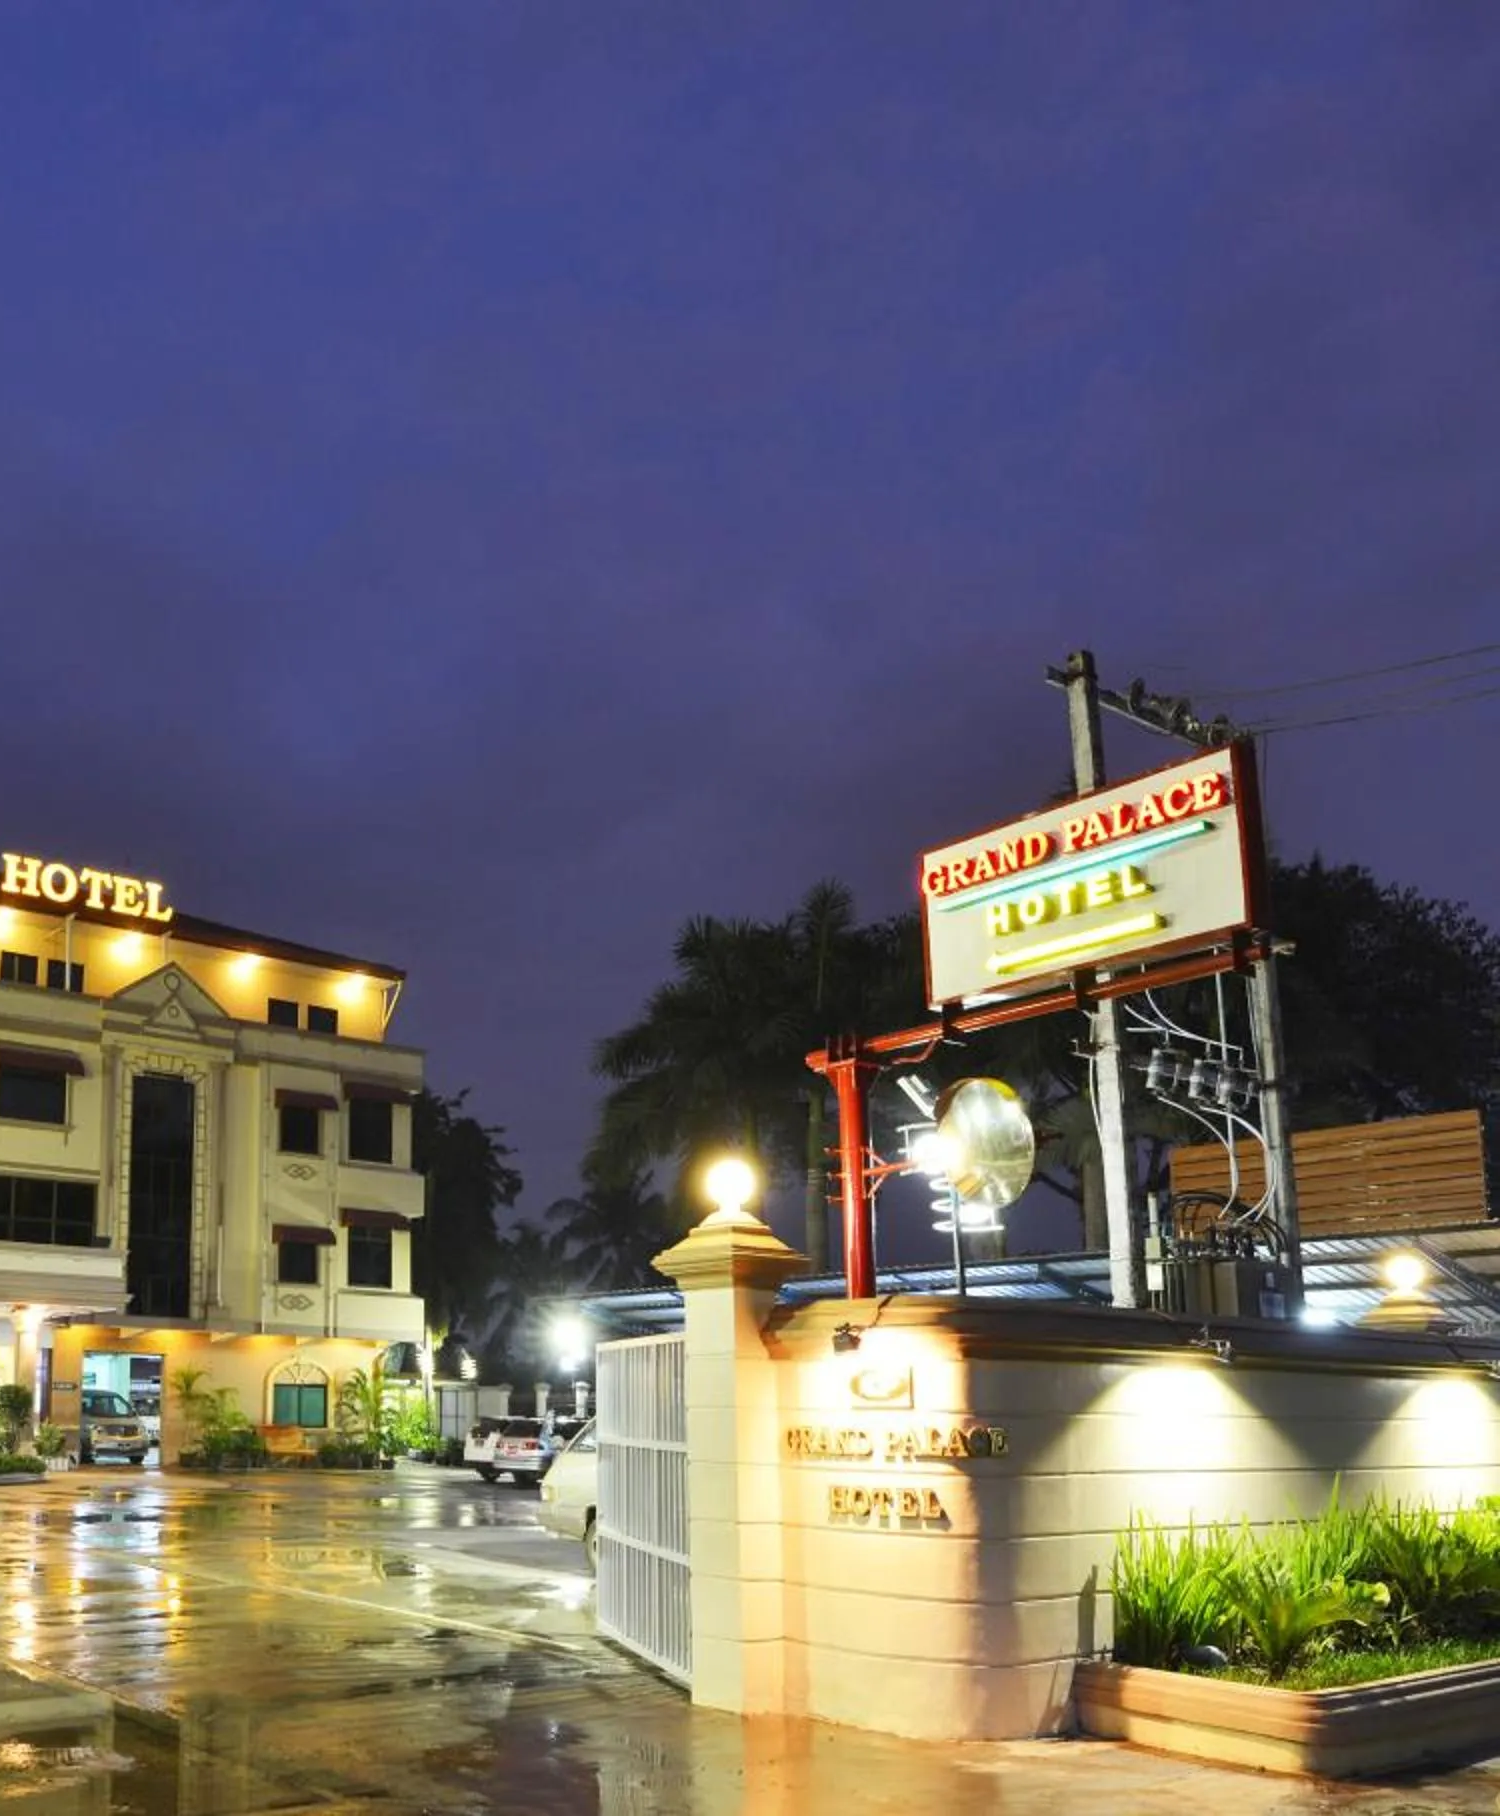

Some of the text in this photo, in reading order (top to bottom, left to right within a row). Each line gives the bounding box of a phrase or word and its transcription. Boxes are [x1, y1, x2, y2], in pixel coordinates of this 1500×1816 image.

[921, 771, 1224, 897] GRAND PALACE
[0, 853, 174, 922] HOTEL
[985, 864, 1150, 937] HOTEL
[828, 1486, 947, 1519] HOTEL
